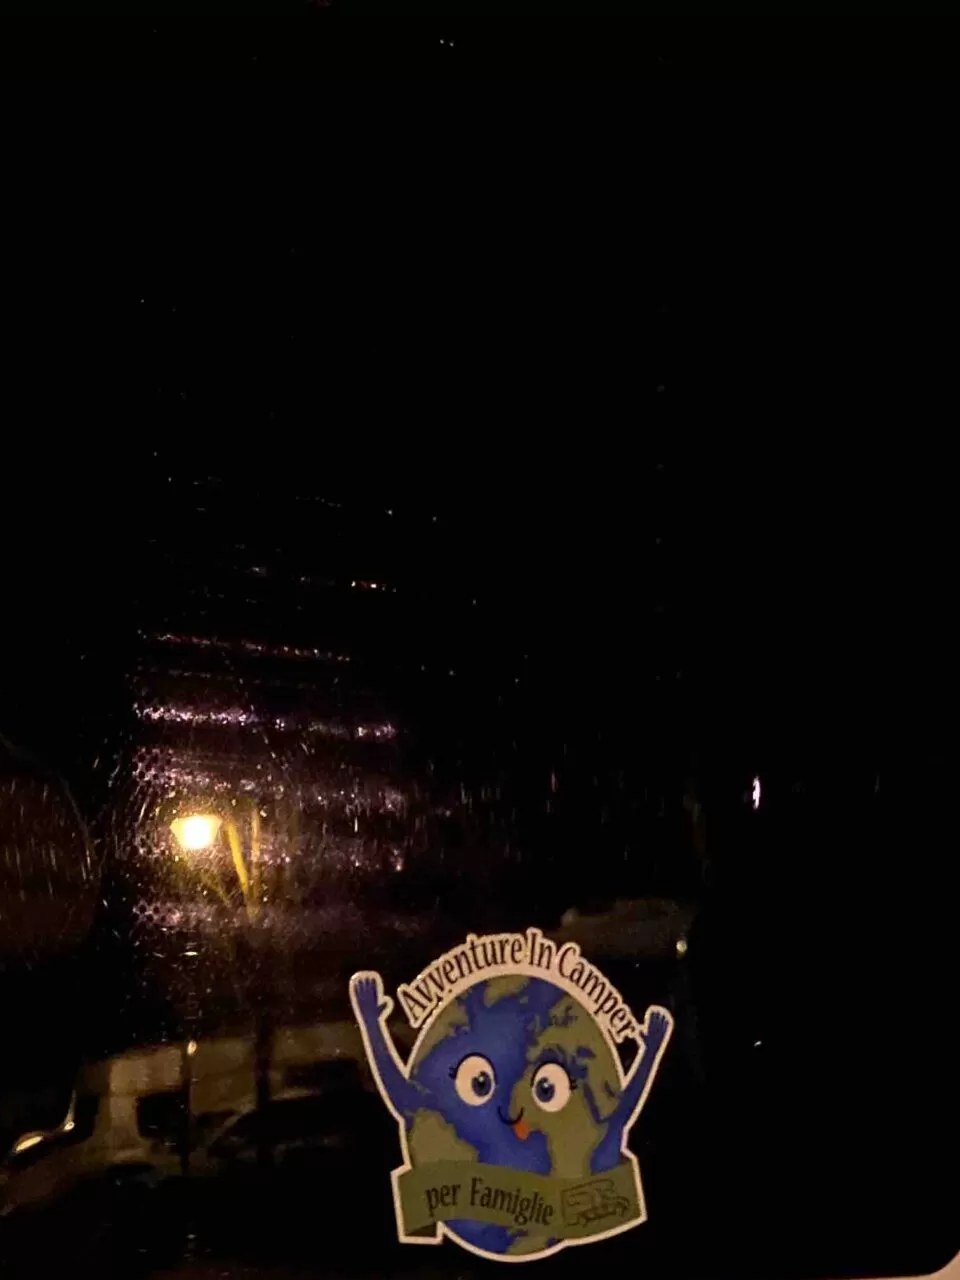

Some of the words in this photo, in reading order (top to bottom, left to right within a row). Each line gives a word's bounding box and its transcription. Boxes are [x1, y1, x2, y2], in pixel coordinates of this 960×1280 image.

[400, 936, 522, 1021] Avventure
[528, 932, 552, 968] In
[557, 946, 636, 1038] Camper
[425, 1182, 461, 1215] per
[470, 1177, 554, 1226] Famiglie
